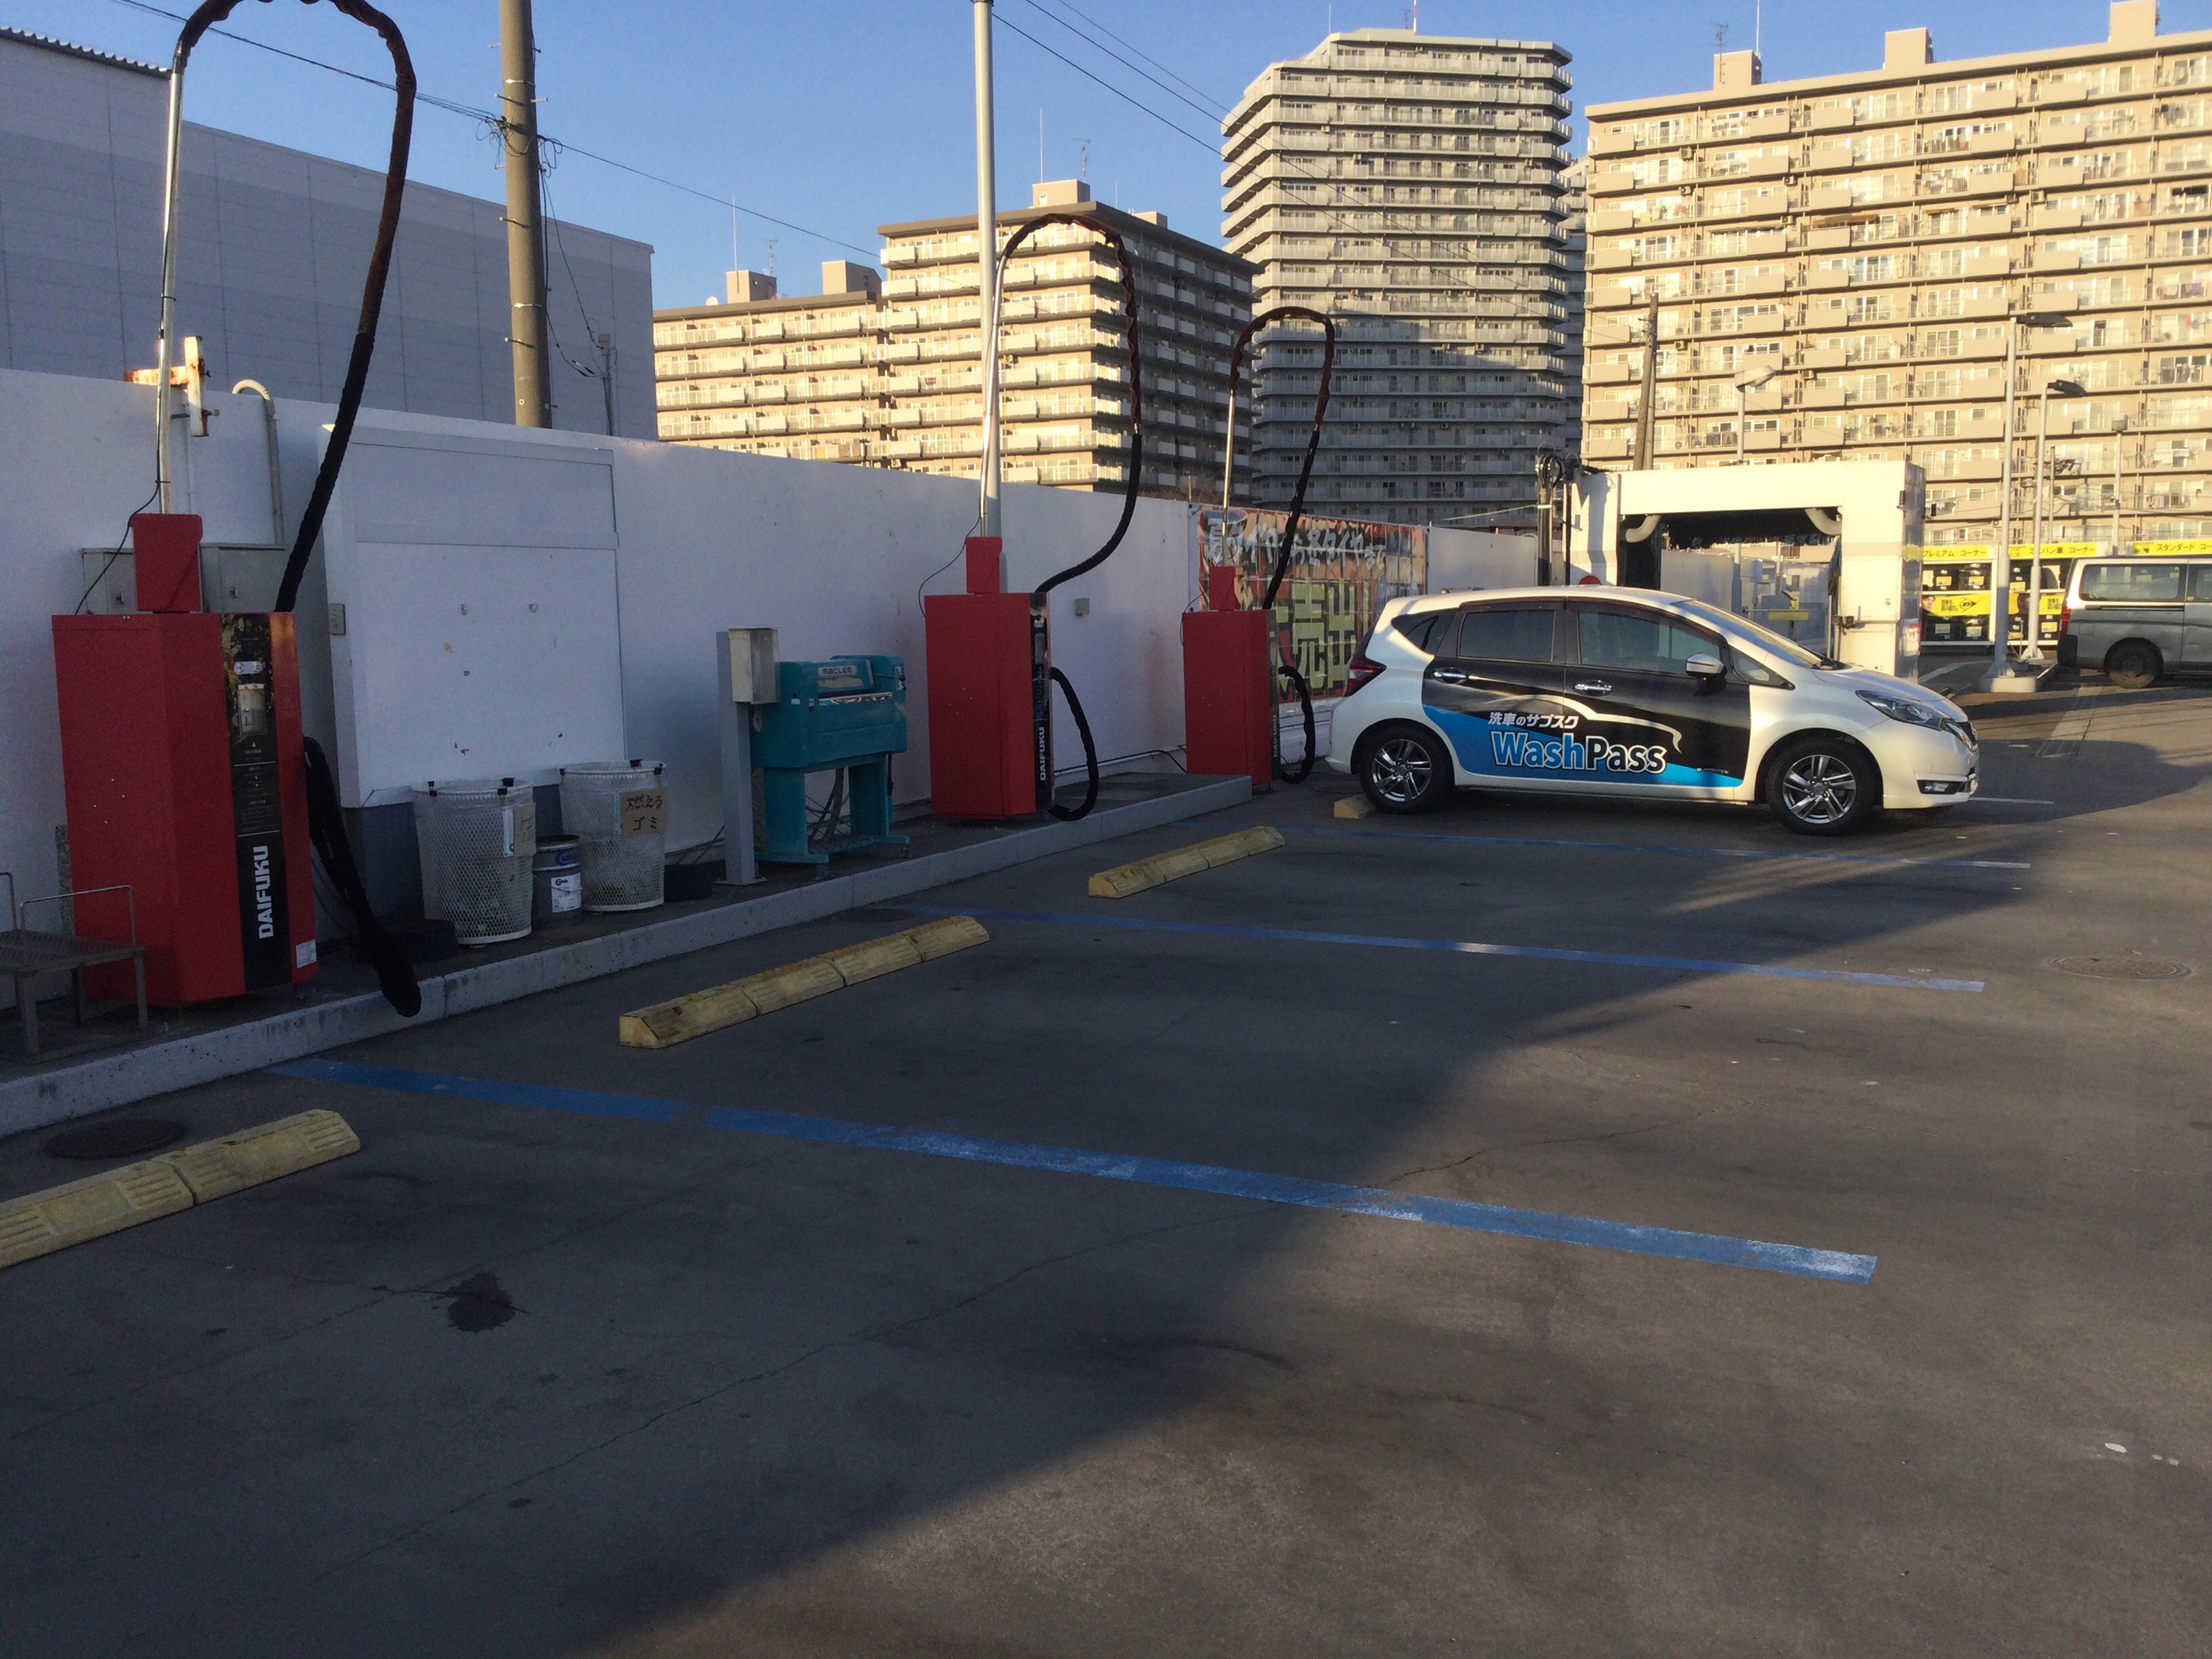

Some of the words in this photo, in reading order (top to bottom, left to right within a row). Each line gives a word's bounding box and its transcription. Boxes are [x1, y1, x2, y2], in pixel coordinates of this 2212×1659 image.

[1206, 524, 1386, 570] 夏タイヤら冬タイヤまで
[1488, 712, 1579, 729] 洗車のサブスク
[1490, 730, 1668, 775] WashPass
[626, 794, 663, 811] 燃える
[633, 815, 658, 831] ゴミ
[253, 845, 274, 939] DAIFUKU
